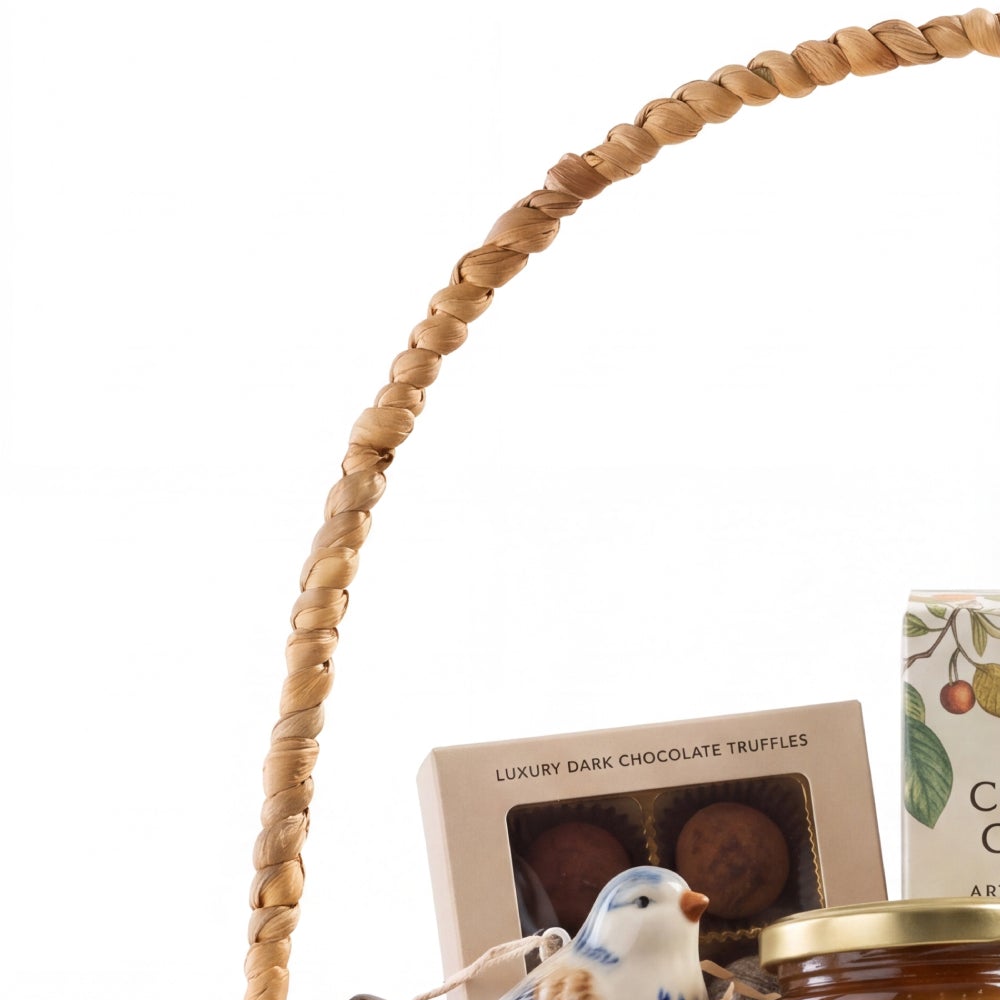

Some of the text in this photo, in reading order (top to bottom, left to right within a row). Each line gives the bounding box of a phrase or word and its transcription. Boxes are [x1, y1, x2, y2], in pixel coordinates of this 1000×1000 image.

[496, 733, 808, 782] LUXURY DARK CHOCOLATE TRUFFLES
